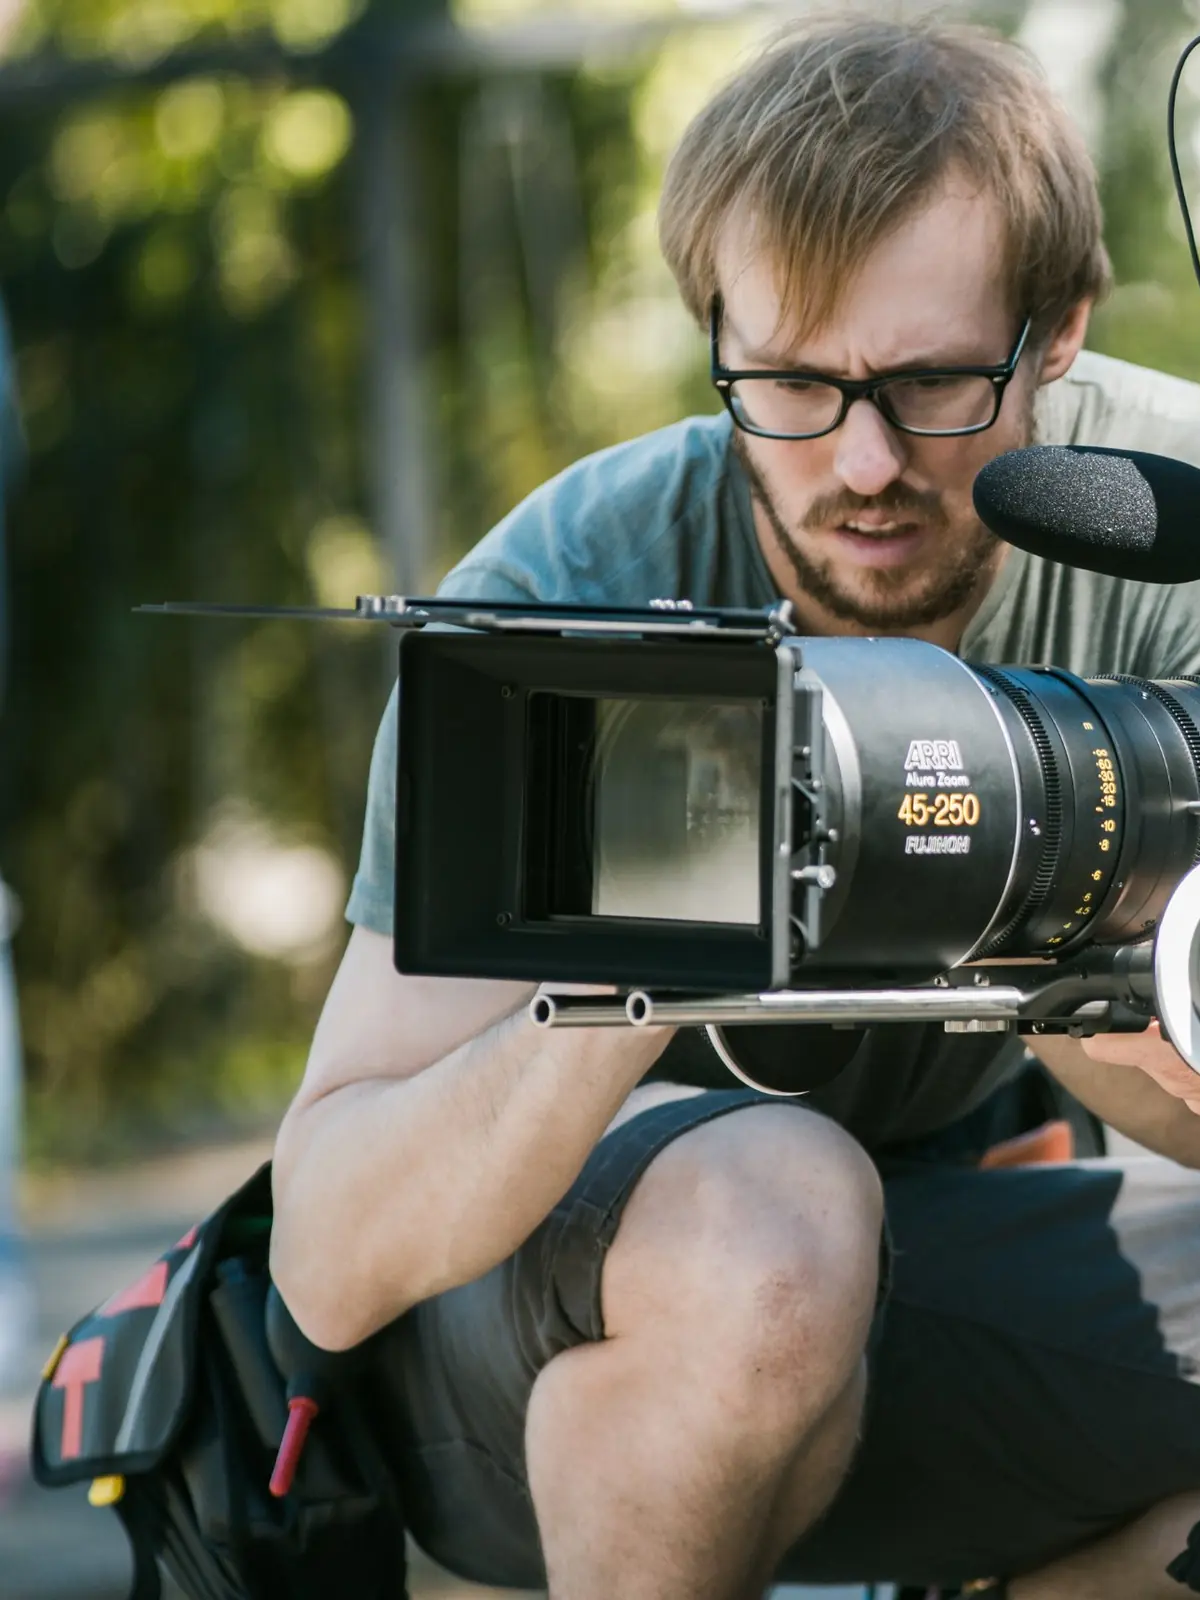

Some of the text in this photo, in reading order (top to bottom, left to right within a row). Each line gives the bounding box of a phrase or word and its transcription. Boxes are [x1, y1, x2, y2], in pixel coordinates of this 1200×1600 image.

[904, 740, 963, 770] ARRI
[1099, 759, 1112, 770] 60
[936, 772, 970, 787] Zoom
[1101, 771, 1114, 782] 30
[1103, 783, 1116, 794] 20
[1104, 795, 1116, 807] 15
[897, 793, 980, 826] 45-250
[1104, 820, 1116, 832] 10
[905, 835, 971, 854] FUJINON
[1101, 839, 1110, 851] 8
